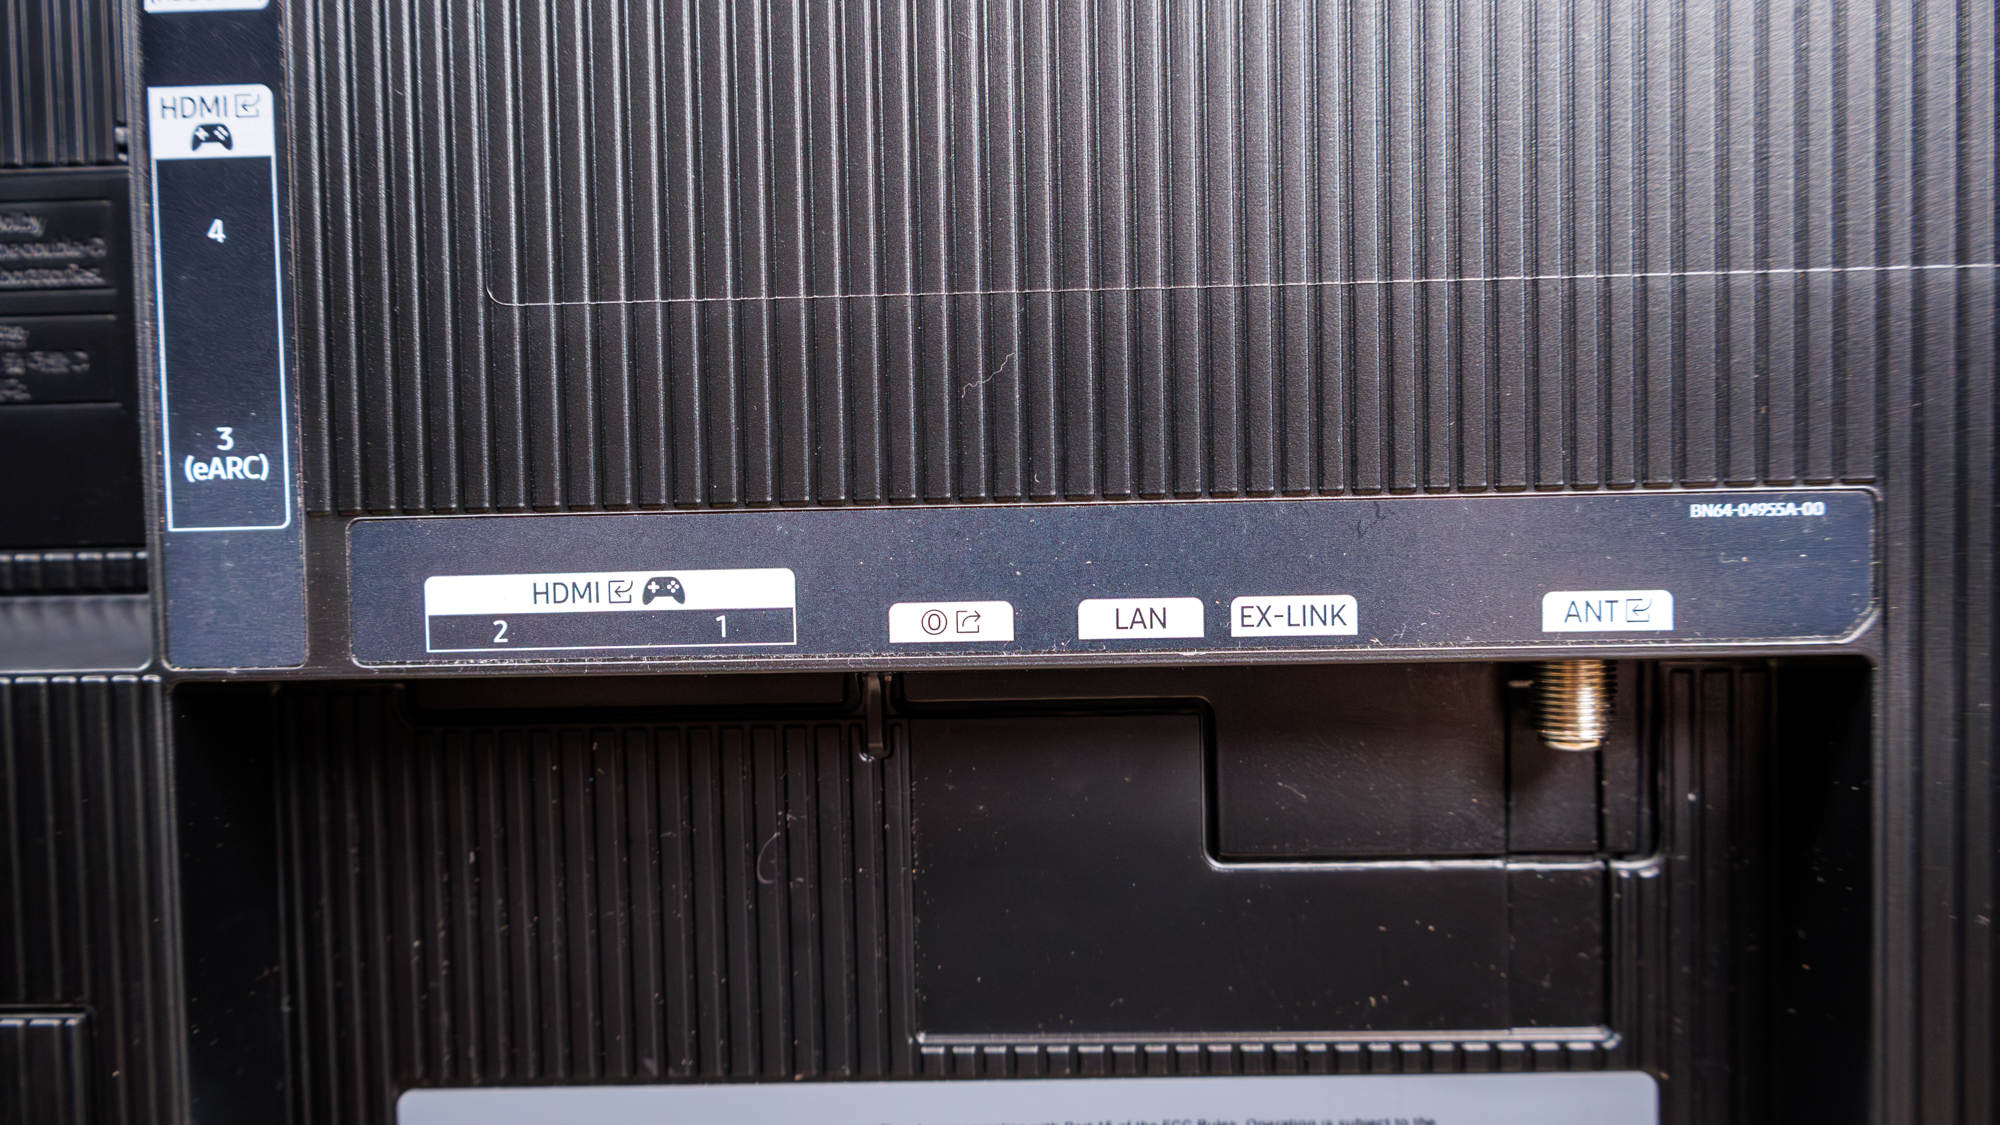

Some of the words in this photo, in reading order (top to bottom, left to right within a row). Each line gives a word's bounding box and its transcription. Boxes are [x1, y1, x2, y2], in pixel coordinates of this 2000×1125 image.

[160, 95, 228, 120] HDMI
[207, 218, 227, 243] 4
[215, 426, 235, 451] 3
[184, 453, 270, 483] (eARC)
[1689, 501, 1826, 518] BN64-04955A-00
[532, 581, 600, 605] HDMI
[1115, 607, 1168, 631] LAN
[1240, 604, 1348, 628] EX-LINK
[1564, 599, 1619, 623] ANT
[493, 620, 509, 643] 2
[715, 614, 727, 638] 1
